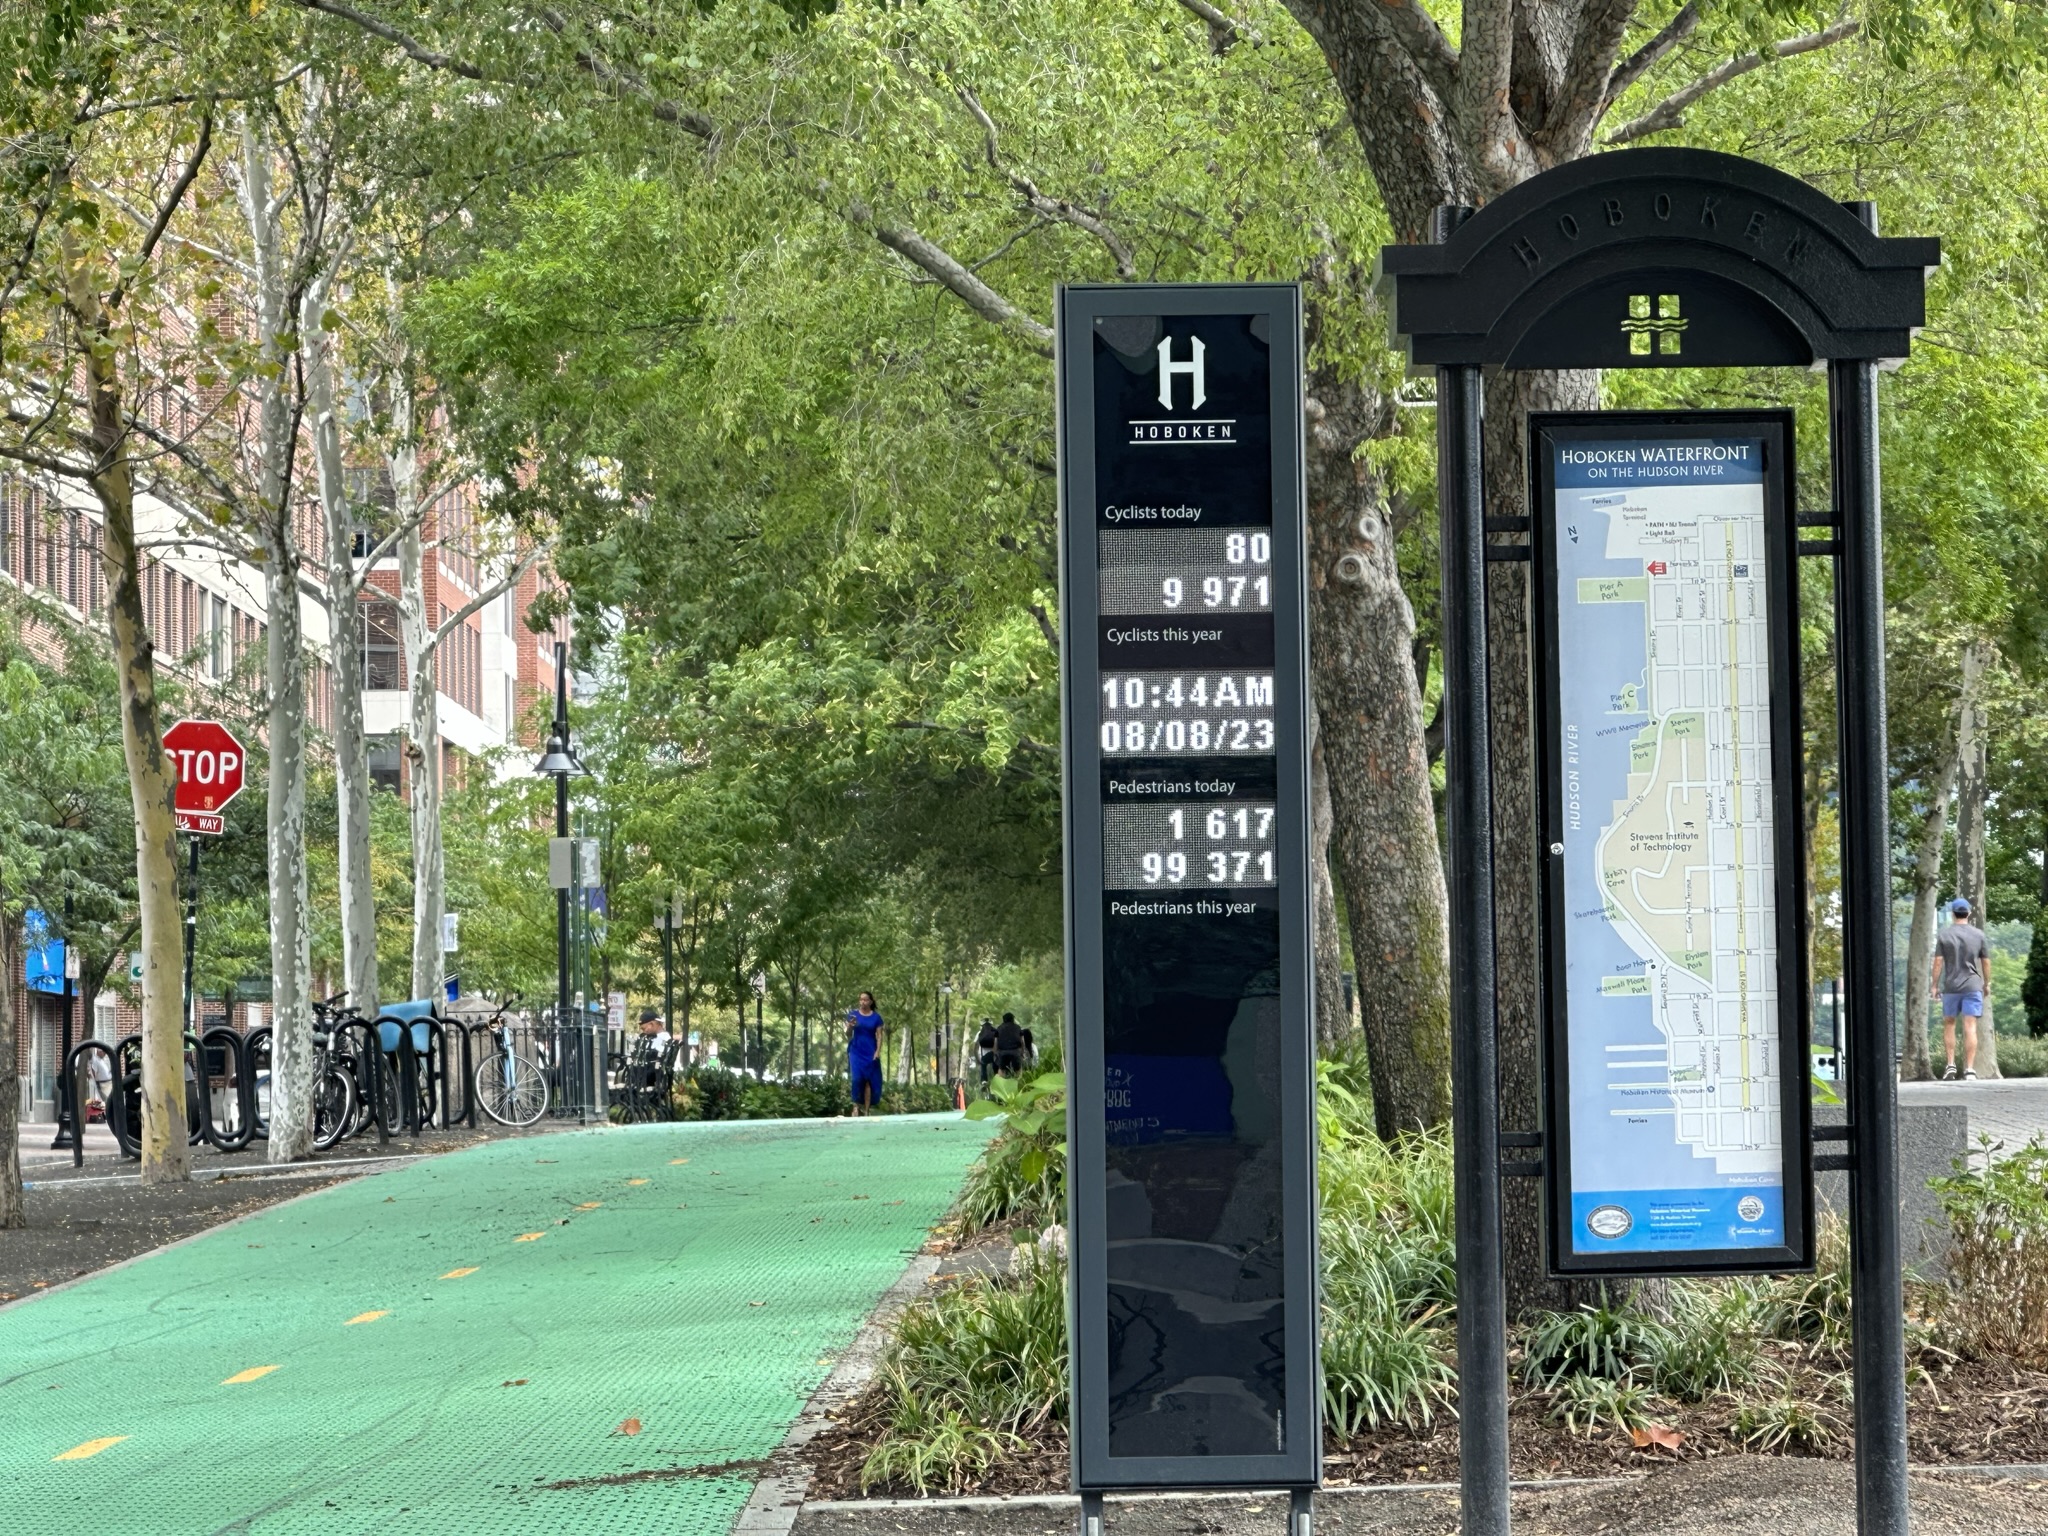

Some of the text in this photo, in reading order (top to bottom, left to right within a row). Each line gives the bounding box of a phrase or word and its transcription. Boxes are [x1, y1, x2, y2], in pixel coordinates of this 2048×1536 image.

[1510, 192, 1813, 269] HOBOKEN
[1157, 335, 1206, 411] H
[1135, 425, 1231, 438] HOBOKEN
[1562, 446, 1749, 464] HOBOKEN WATERFRONT
[1588, 465, 1724, 478] ON THE HUDSON RIVER
[1105, 504, 1202, 522] Cyclists today
[1227, 533, 1270, 563] 80
[1163, 576, 1269, 608] 9 971
[1107, 628, 1222, 645] Cyclists this year
[1103, 676, 1273, 709] 10:44AM
[1627, 690, 1635, 698] C
[1101, 719, 1274, 751] 08/08/23
[1567, 724, 1581, 830] HUDSON RIVER
[1110, 779, 1236, 795] Pedestrians today
[199, 817, 218, 830] WAY
[1169, 808, 1274, 840] 1 617
[1630, 832, 1699, 841] Stevens Institute
[1630, 842, 1692, 852] of Technology
[1143, 850, 1273, 883] 99 371
[1111, 901, 1256, 917] Pedestrians this year
